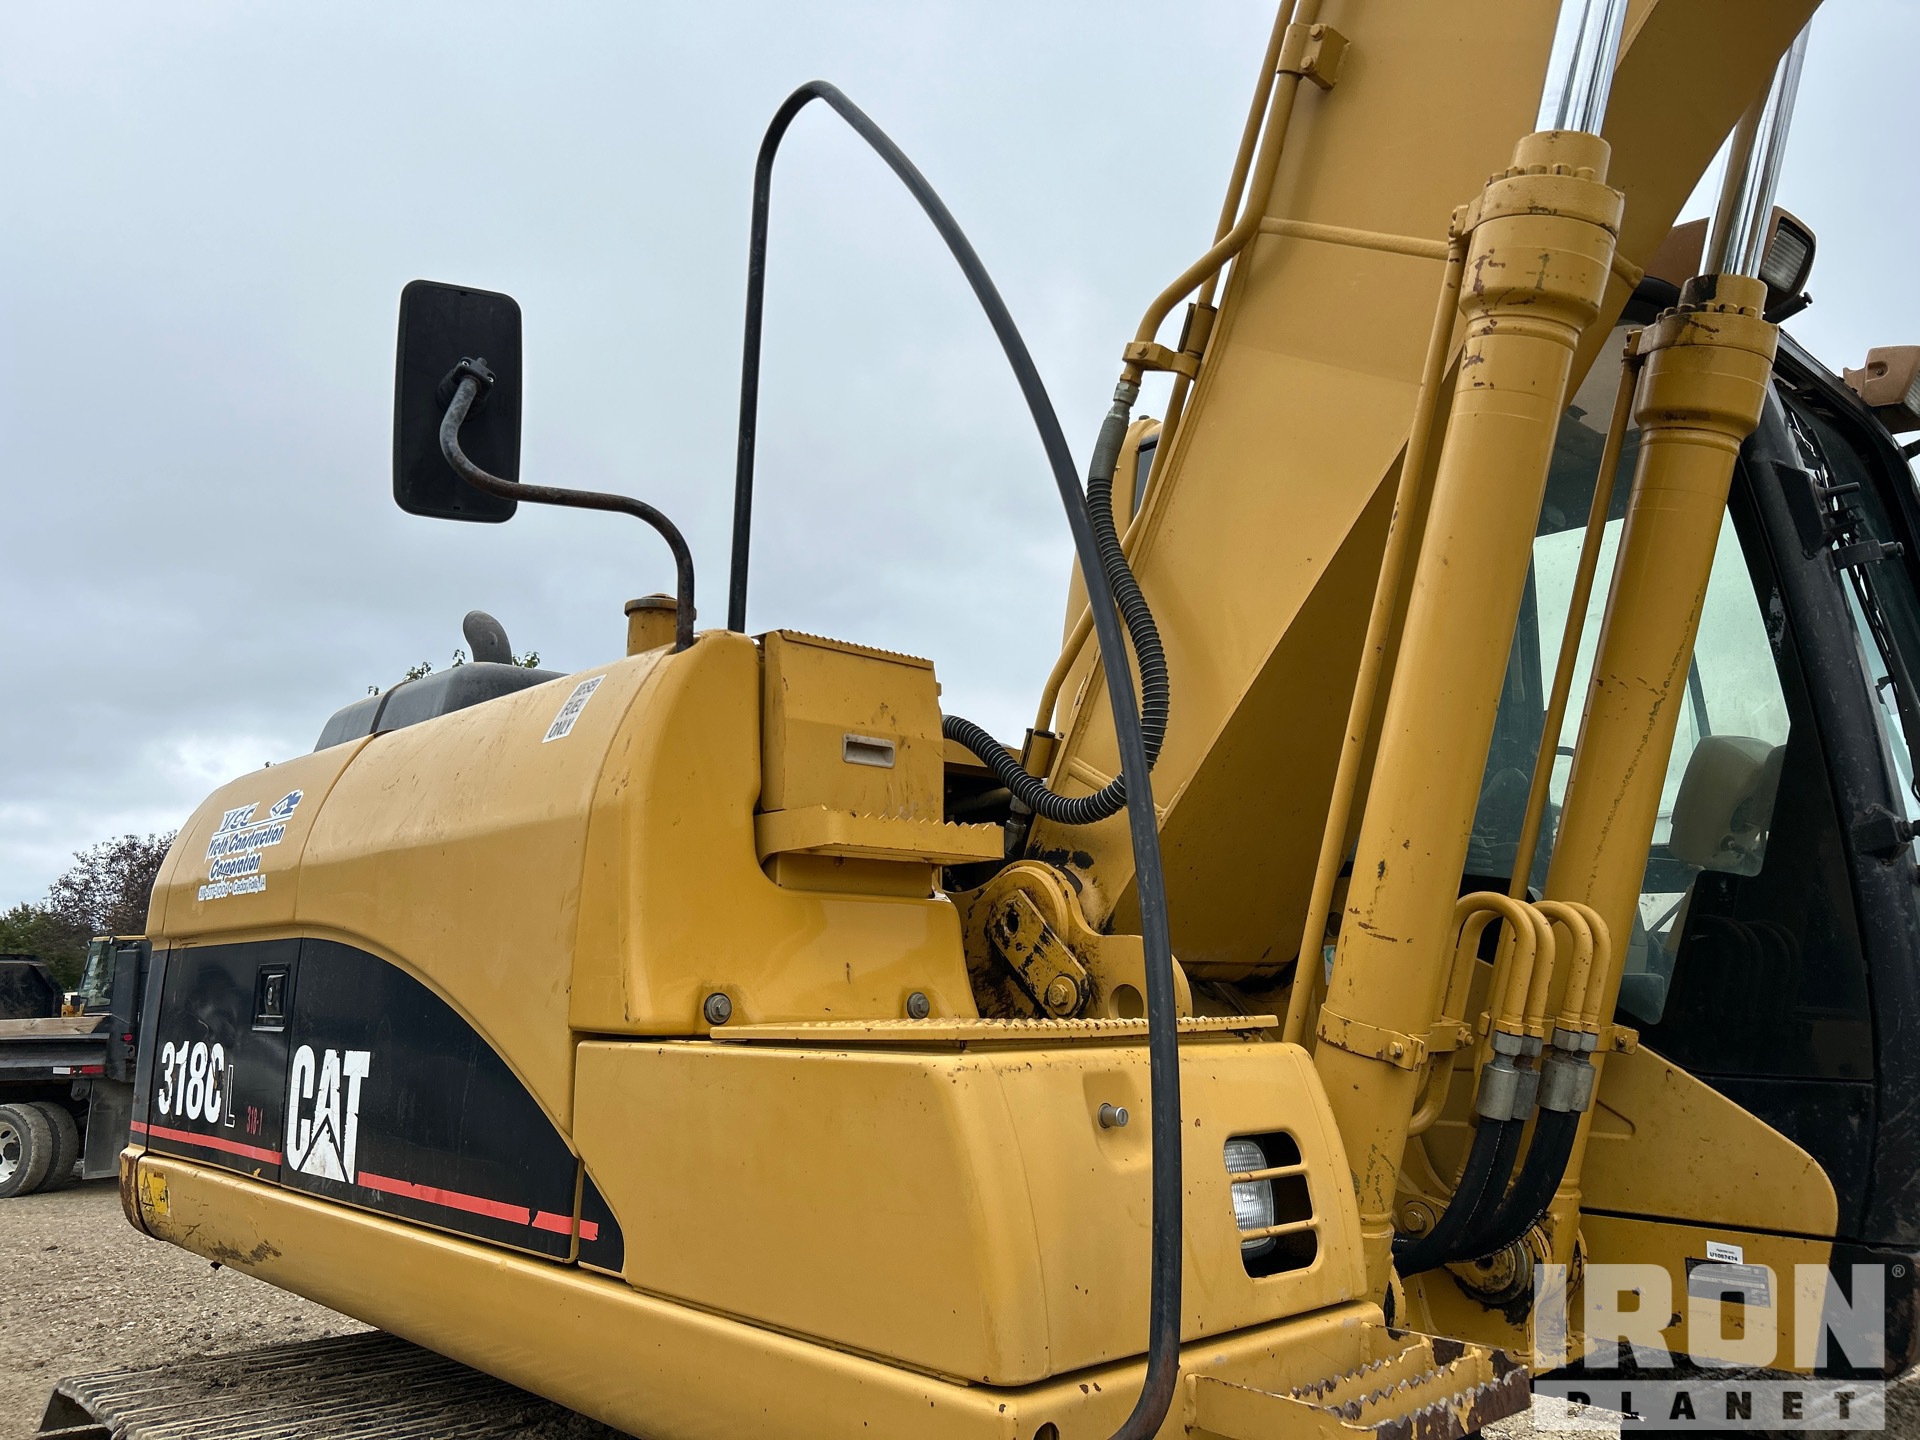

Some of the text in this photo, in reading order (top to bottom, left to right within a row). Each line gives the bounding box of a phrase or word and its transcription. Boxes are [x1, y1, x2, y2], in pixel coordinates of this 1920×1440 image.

[560, 698, 584, 717] FUEL
[229, 823, 285, 853] Construction
[210, 852, 261, 880] Corporation
[286, 1044, 371, 1184] CAT
